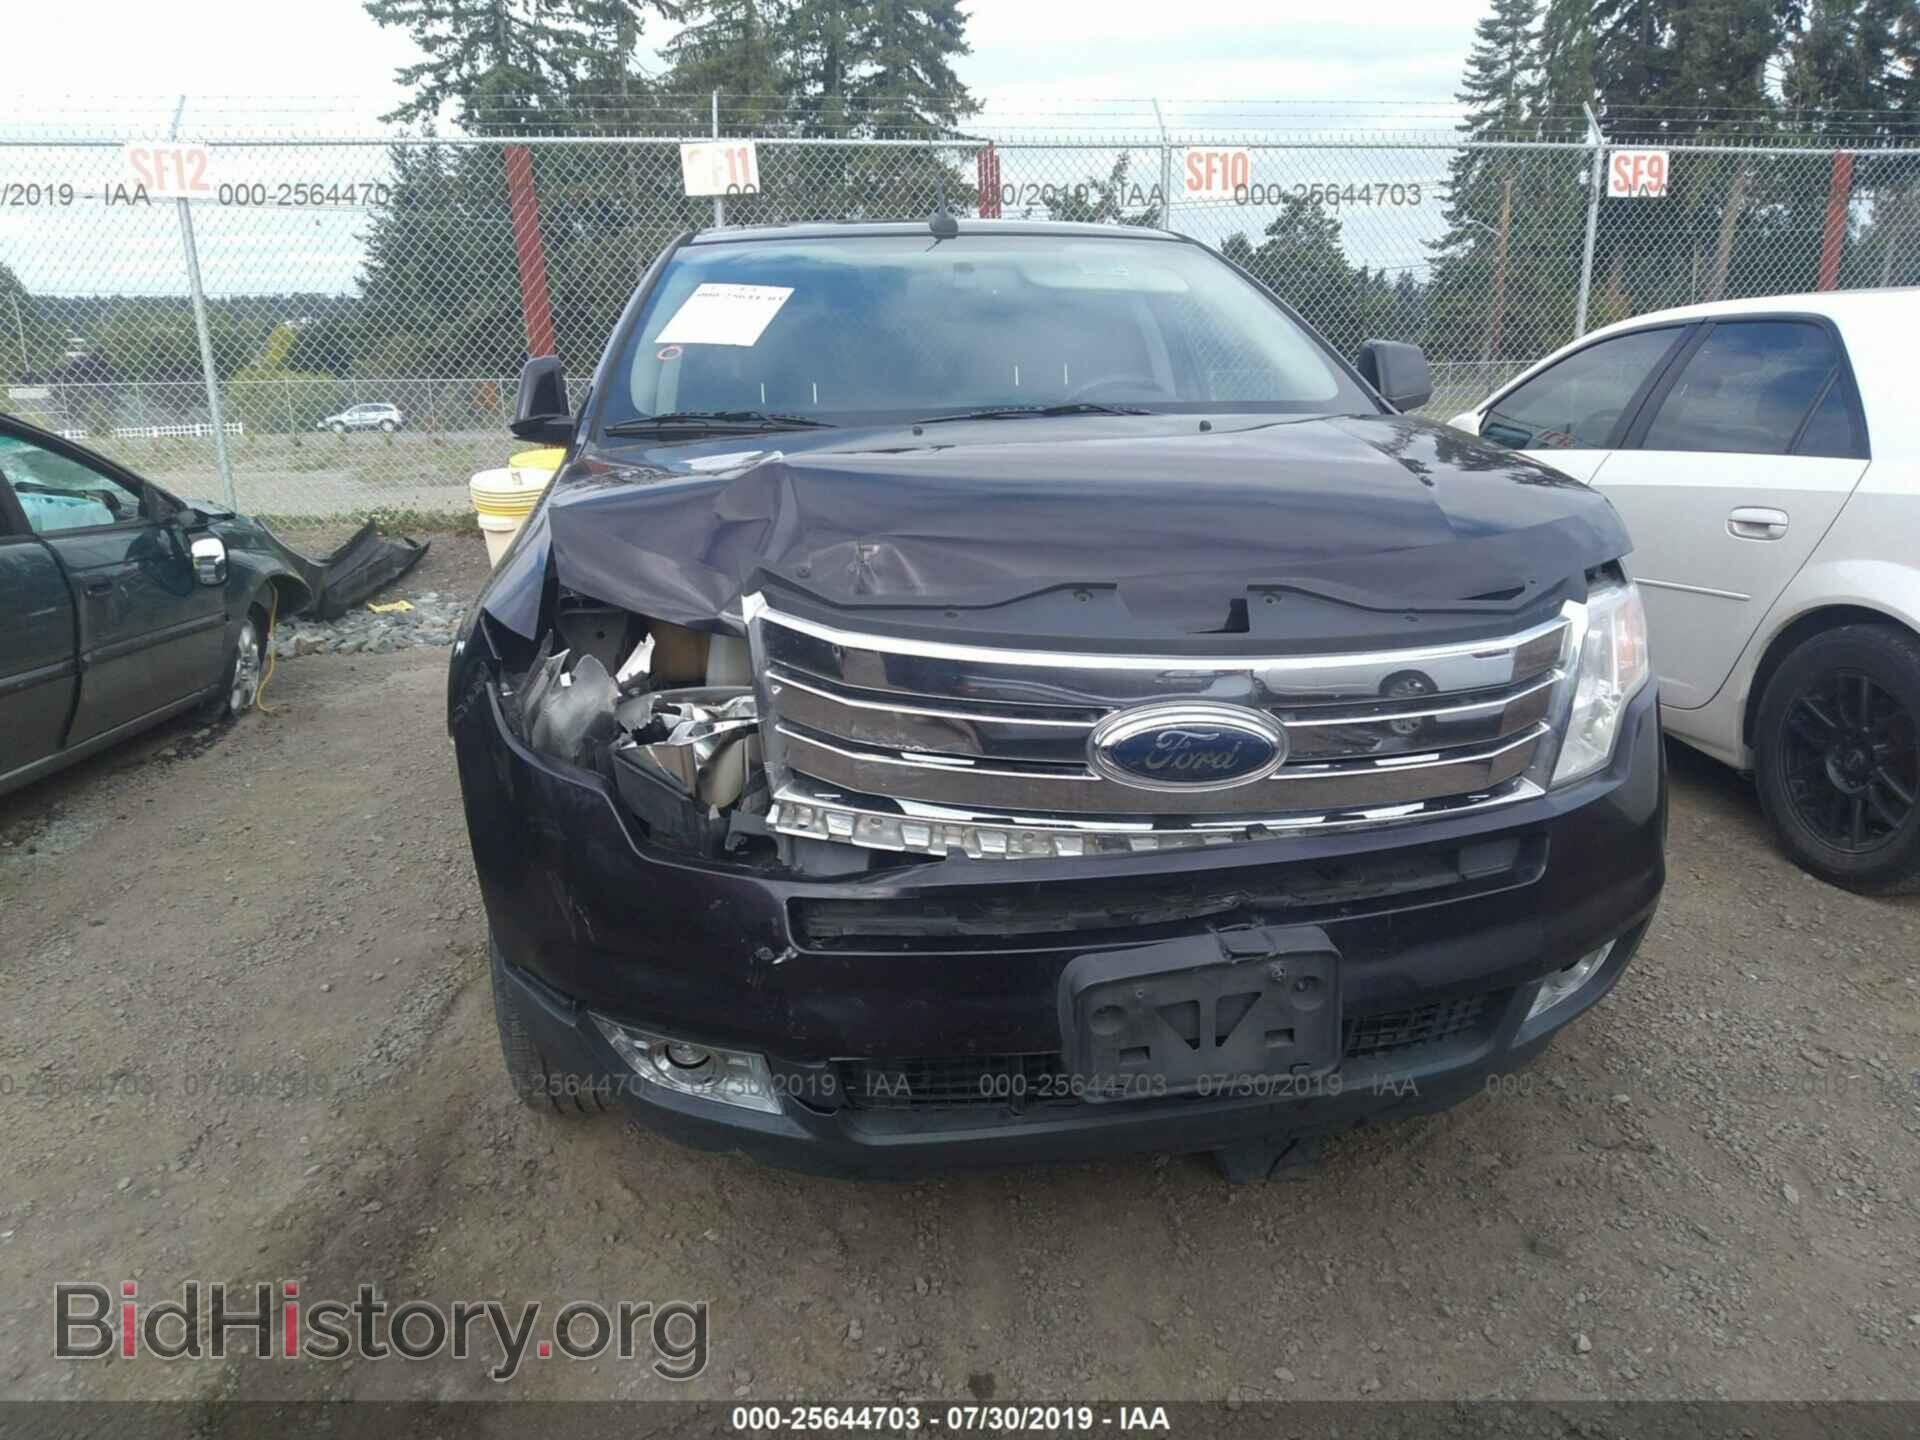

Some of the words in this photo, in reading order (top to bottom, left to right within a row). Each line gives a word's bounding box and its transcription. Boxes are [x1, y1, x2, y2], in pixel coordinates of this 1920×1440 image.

[129, 148, 210, 191] SF12
[1186, 152, 1249, 191] SF10
[1614, 155, 1664, 192] SF9
[1144, 730, 1242, 769] Ford
